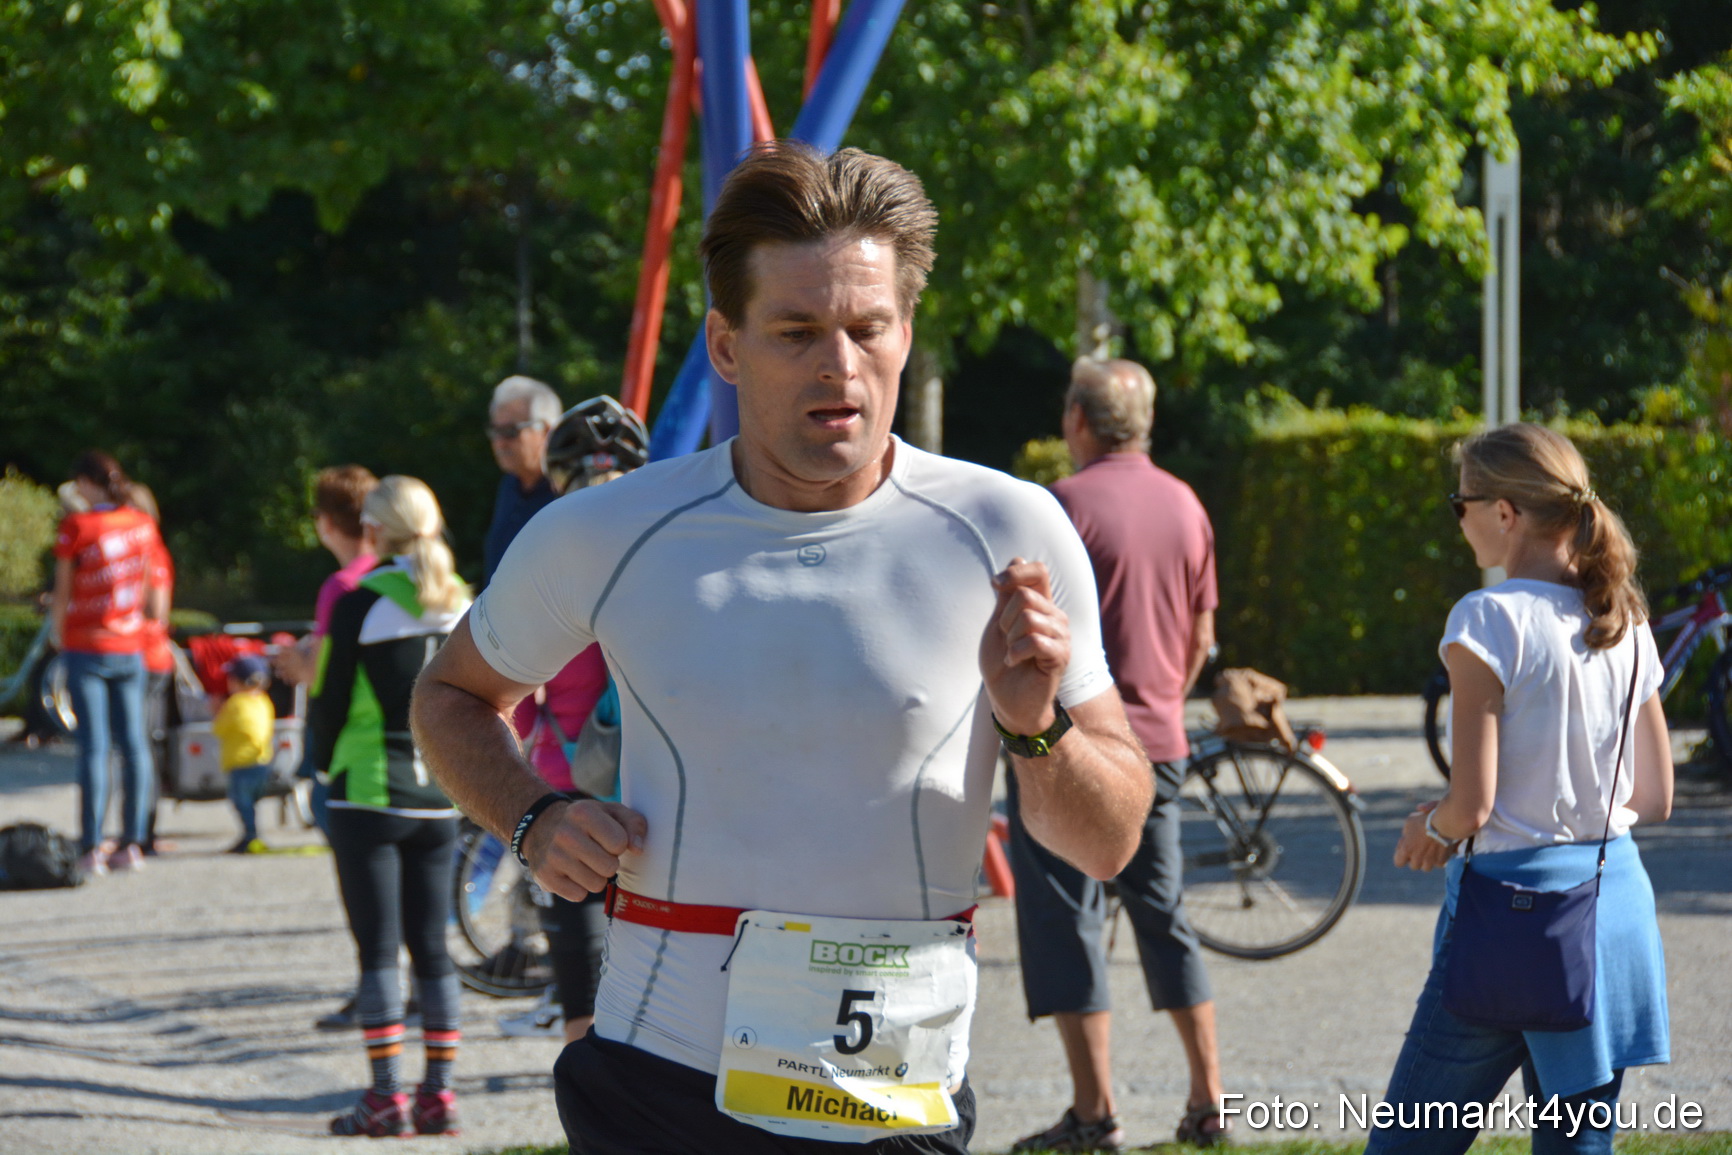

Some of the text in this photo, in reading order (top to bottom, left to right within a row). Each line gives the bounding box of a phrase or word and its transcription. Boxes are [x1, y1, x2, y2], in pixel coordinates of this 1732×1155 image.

[810, 939, 911, 968] BOCK
[808, 964, 910, 978] inspired by smart concepts
[833, 989, 876, 1056] 5
[739, 1033, 749, 1045] A
[777, 1058, 890, 1079] PARTL Neumarkt
